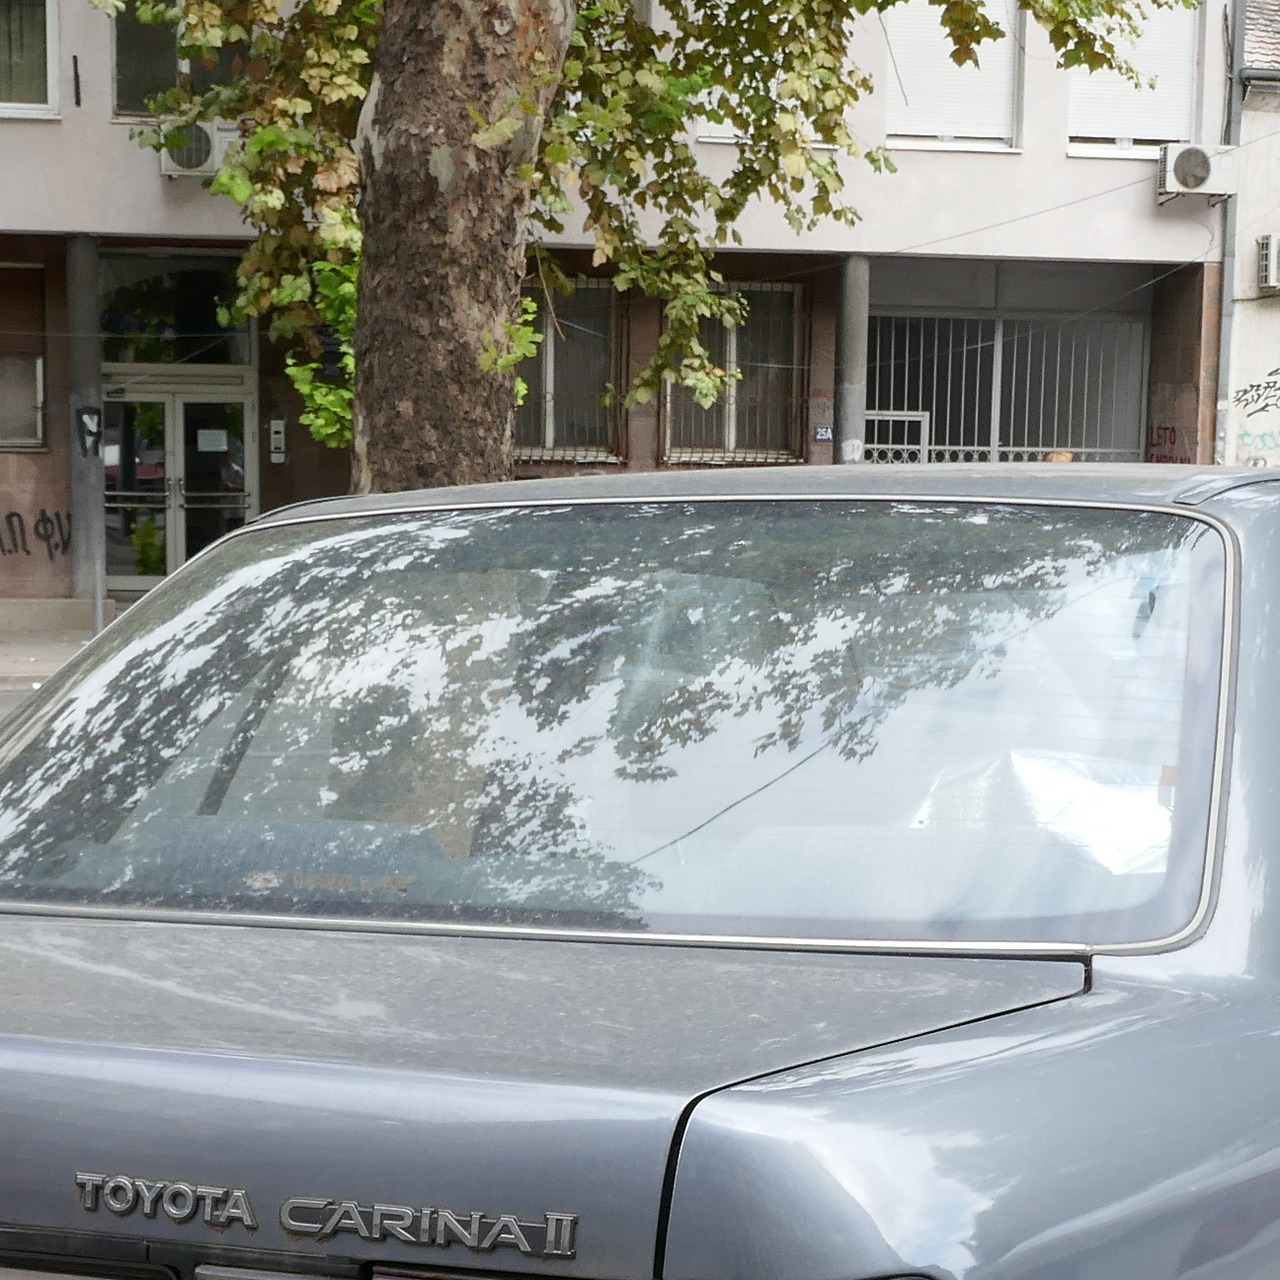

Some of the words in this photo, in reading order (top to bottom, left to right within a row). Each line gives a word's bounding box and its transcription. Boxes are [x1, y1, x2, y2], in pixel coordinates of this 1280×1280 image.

[816, 427, 833, 440] 25A
[75, 1171, 259, 1230] TOYOTA
[279, 1197, 532, 1254] CARINA
[543, 1210, 580, 1259] II
